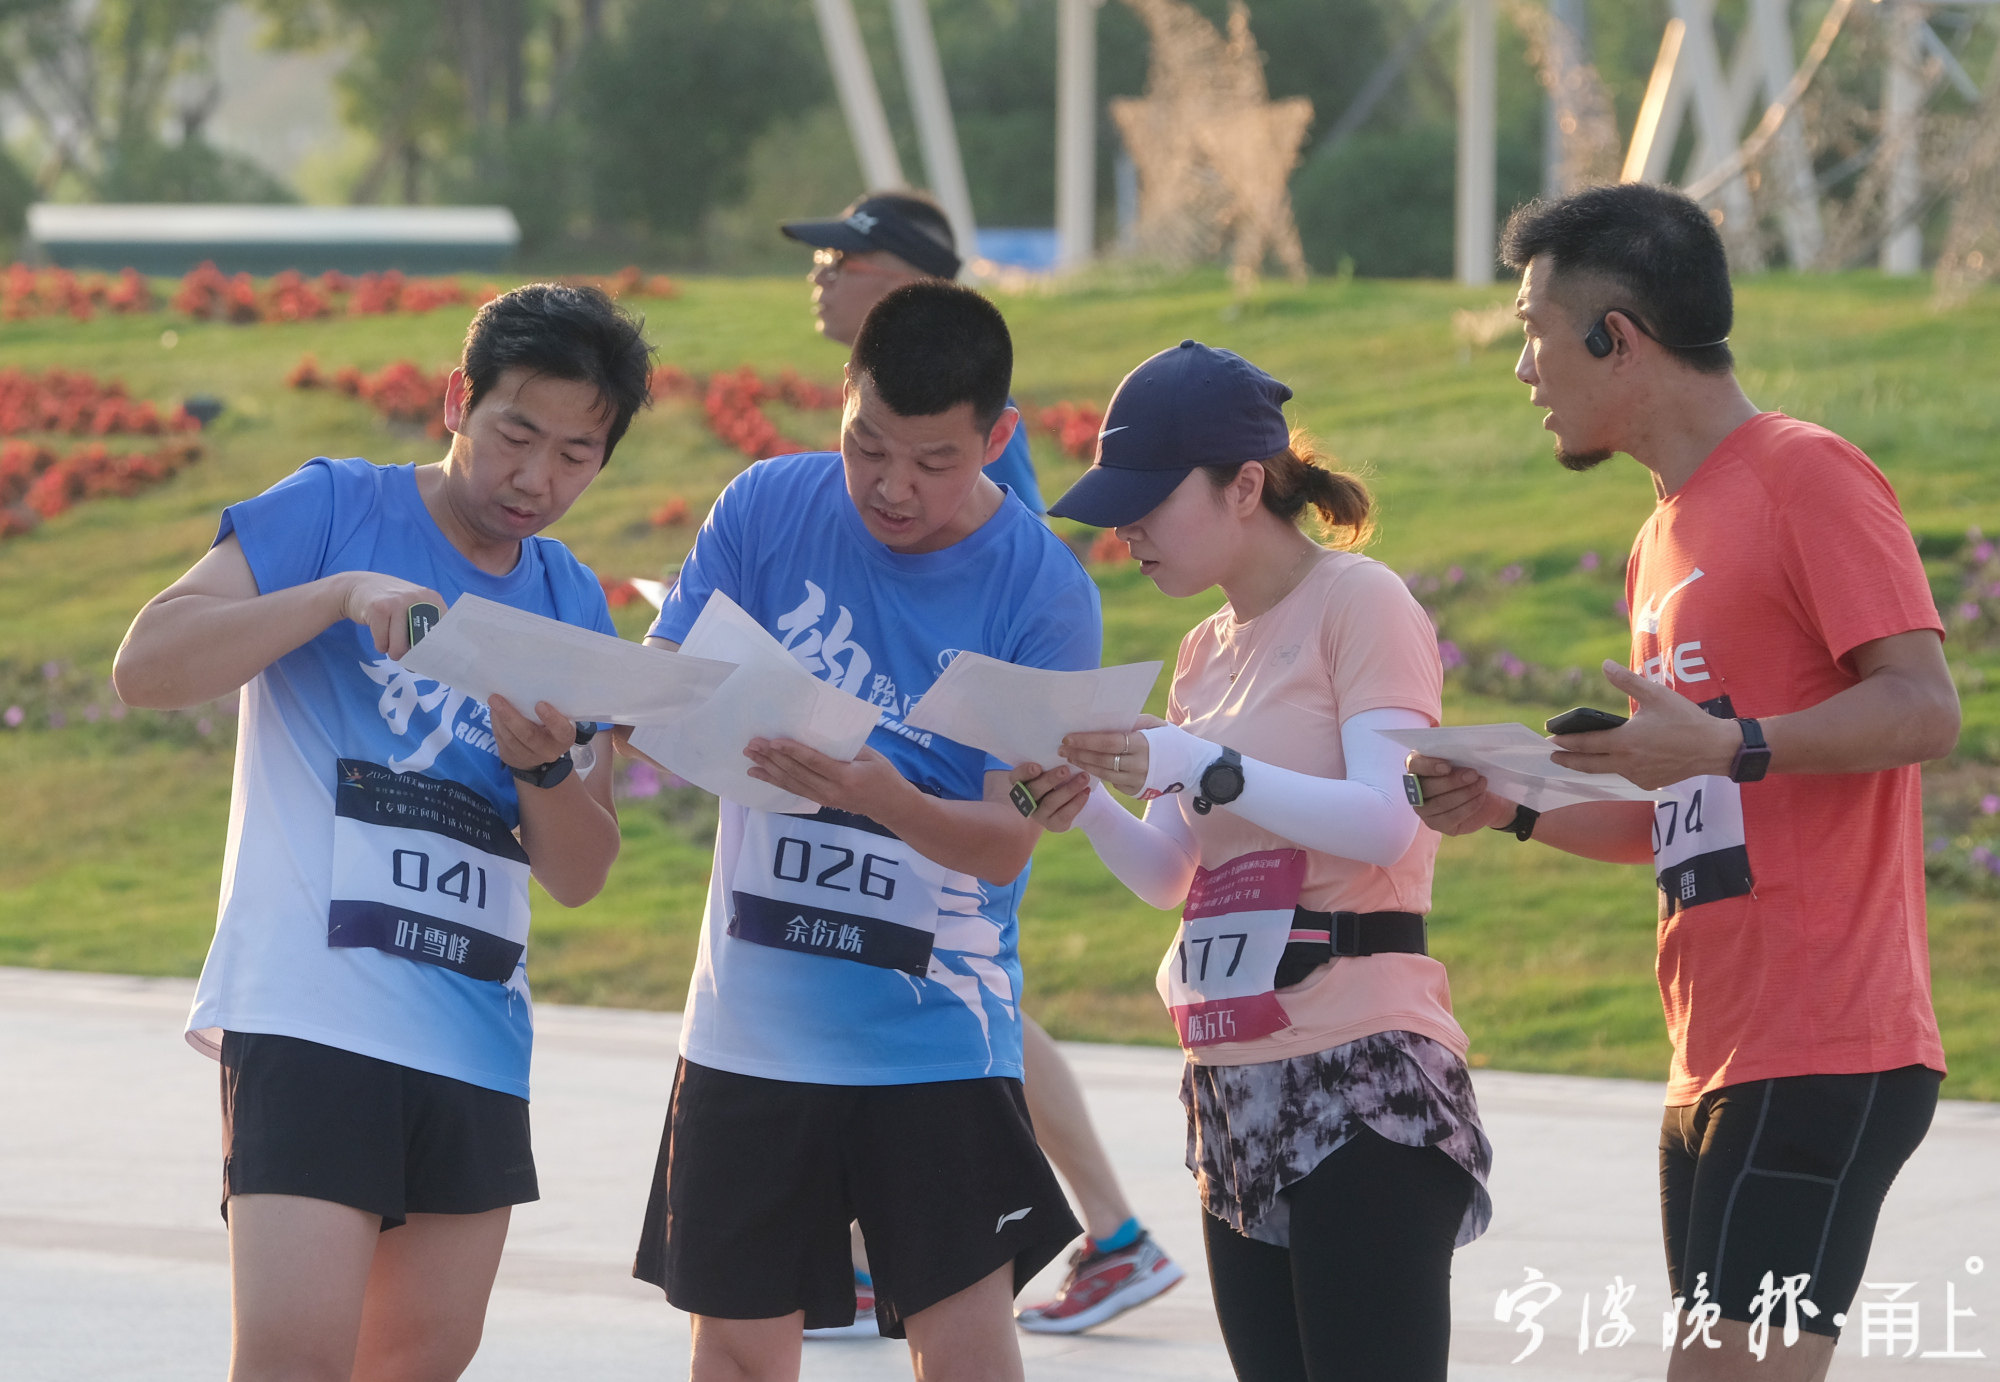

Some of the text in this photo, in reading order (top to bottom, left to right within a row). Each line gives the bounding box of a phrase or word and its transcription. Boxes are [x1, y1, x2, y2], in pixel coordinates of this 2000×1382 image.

[393, 849, 486, 909] 041
[773, 837, 899, 901] 026
[394, 919, 471, 964] 叶雪峰
[785, 915, 866, 954] 余衍炼
[1179, 933, 1248, 984] 177
